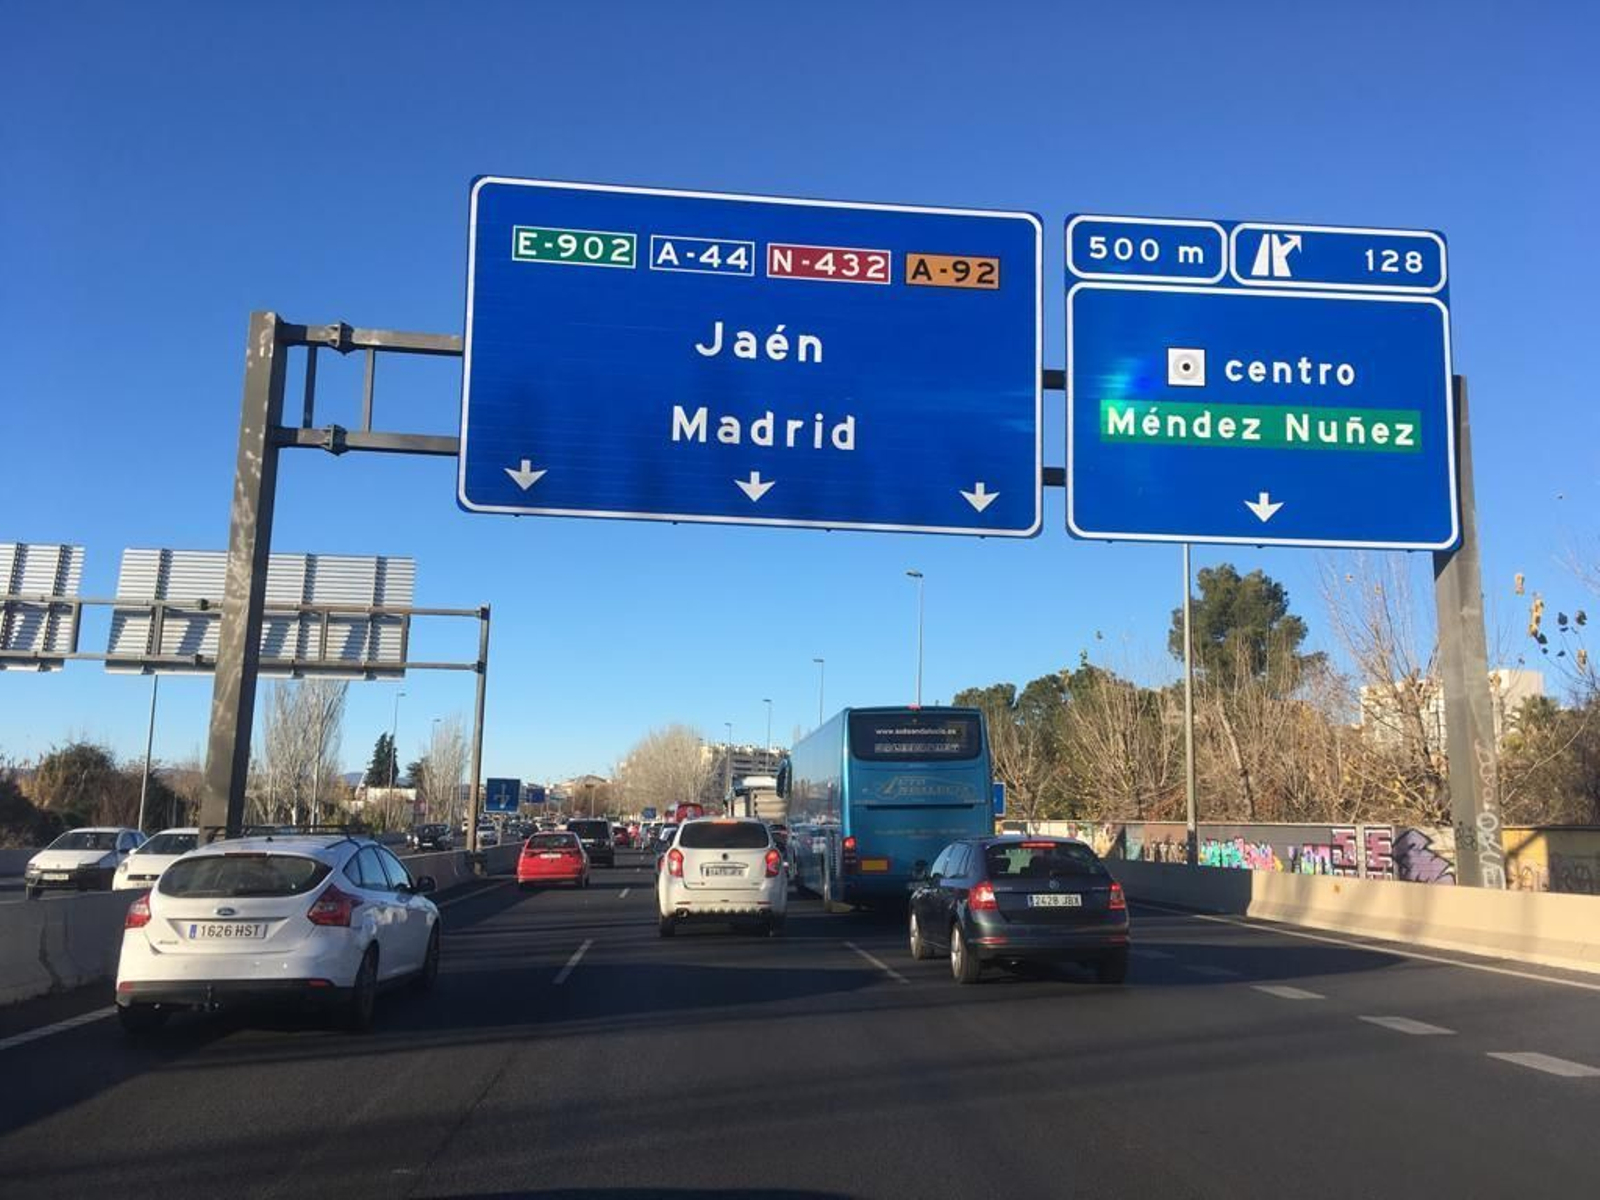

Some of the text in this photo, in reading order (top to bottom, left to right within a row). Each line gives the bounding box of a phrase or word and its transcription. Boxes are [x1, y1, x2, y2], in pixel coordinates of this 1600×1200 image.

[518, 231, 631, 263] E-902
[656, 241, 749, 270] A-44
[1089, 236, 1204, 264] 500 m
[1365, 248, 1423, 274] 128
[772, 249, 886, 279] N-432
[911, 258, 995, 285] A-92
[695, 321, 823, 363] Jaén
[1225, 356, 1355, 386] centro
[672, 405, 855, 451] Madrid
[1105, 404, 1414, 446] Méndez Nuñez
[201, 924, 259, 938] 1626 HST
